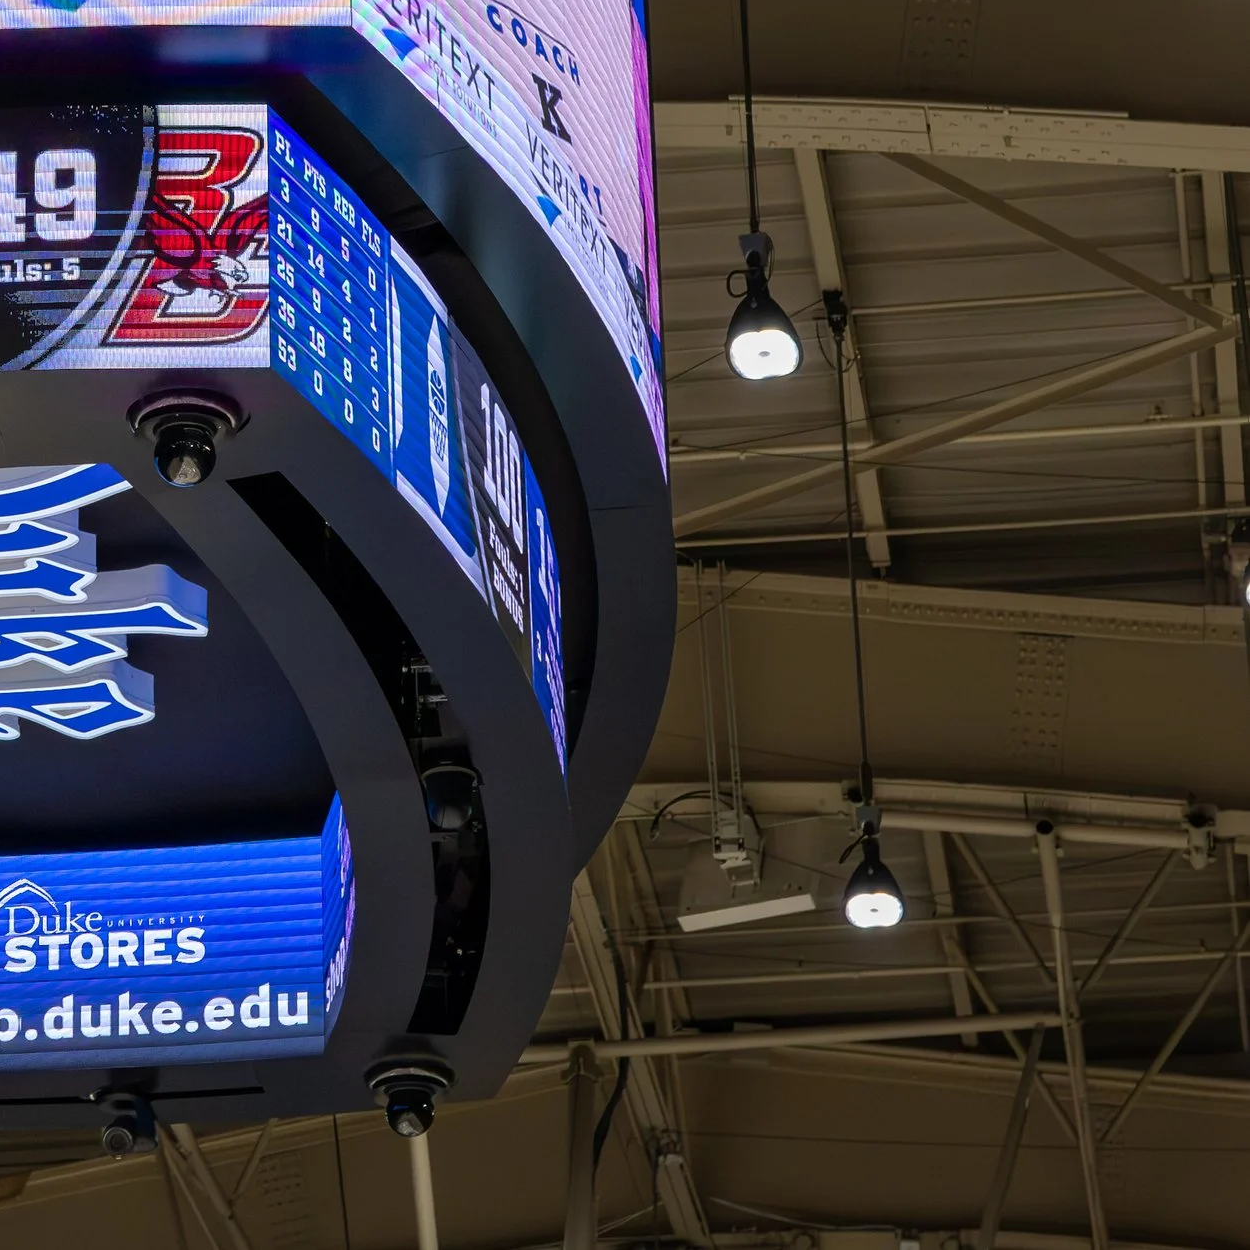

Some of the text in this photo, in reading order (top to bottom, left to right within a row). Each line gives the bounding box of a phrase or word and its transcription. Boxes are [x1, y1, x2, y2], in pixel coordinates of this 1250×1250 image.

[486, 4, 581, 87] COACH
[532, 72, 572, 146] K
[275, 130, 381, 258] PL PTS REB FLS
[62, 258, 80, 281] 5
[277, 215, 325, 278] 21 14
[277, 255, 295, 288] 25
[278, 296, 325, 358] 35 18
[279, 337, 296, 371] 53
[481, 383, 523, 554] 100
[5, 900, 205, 937] Duke UNIVERSITY
[5, 927, 205, 973] STORES
